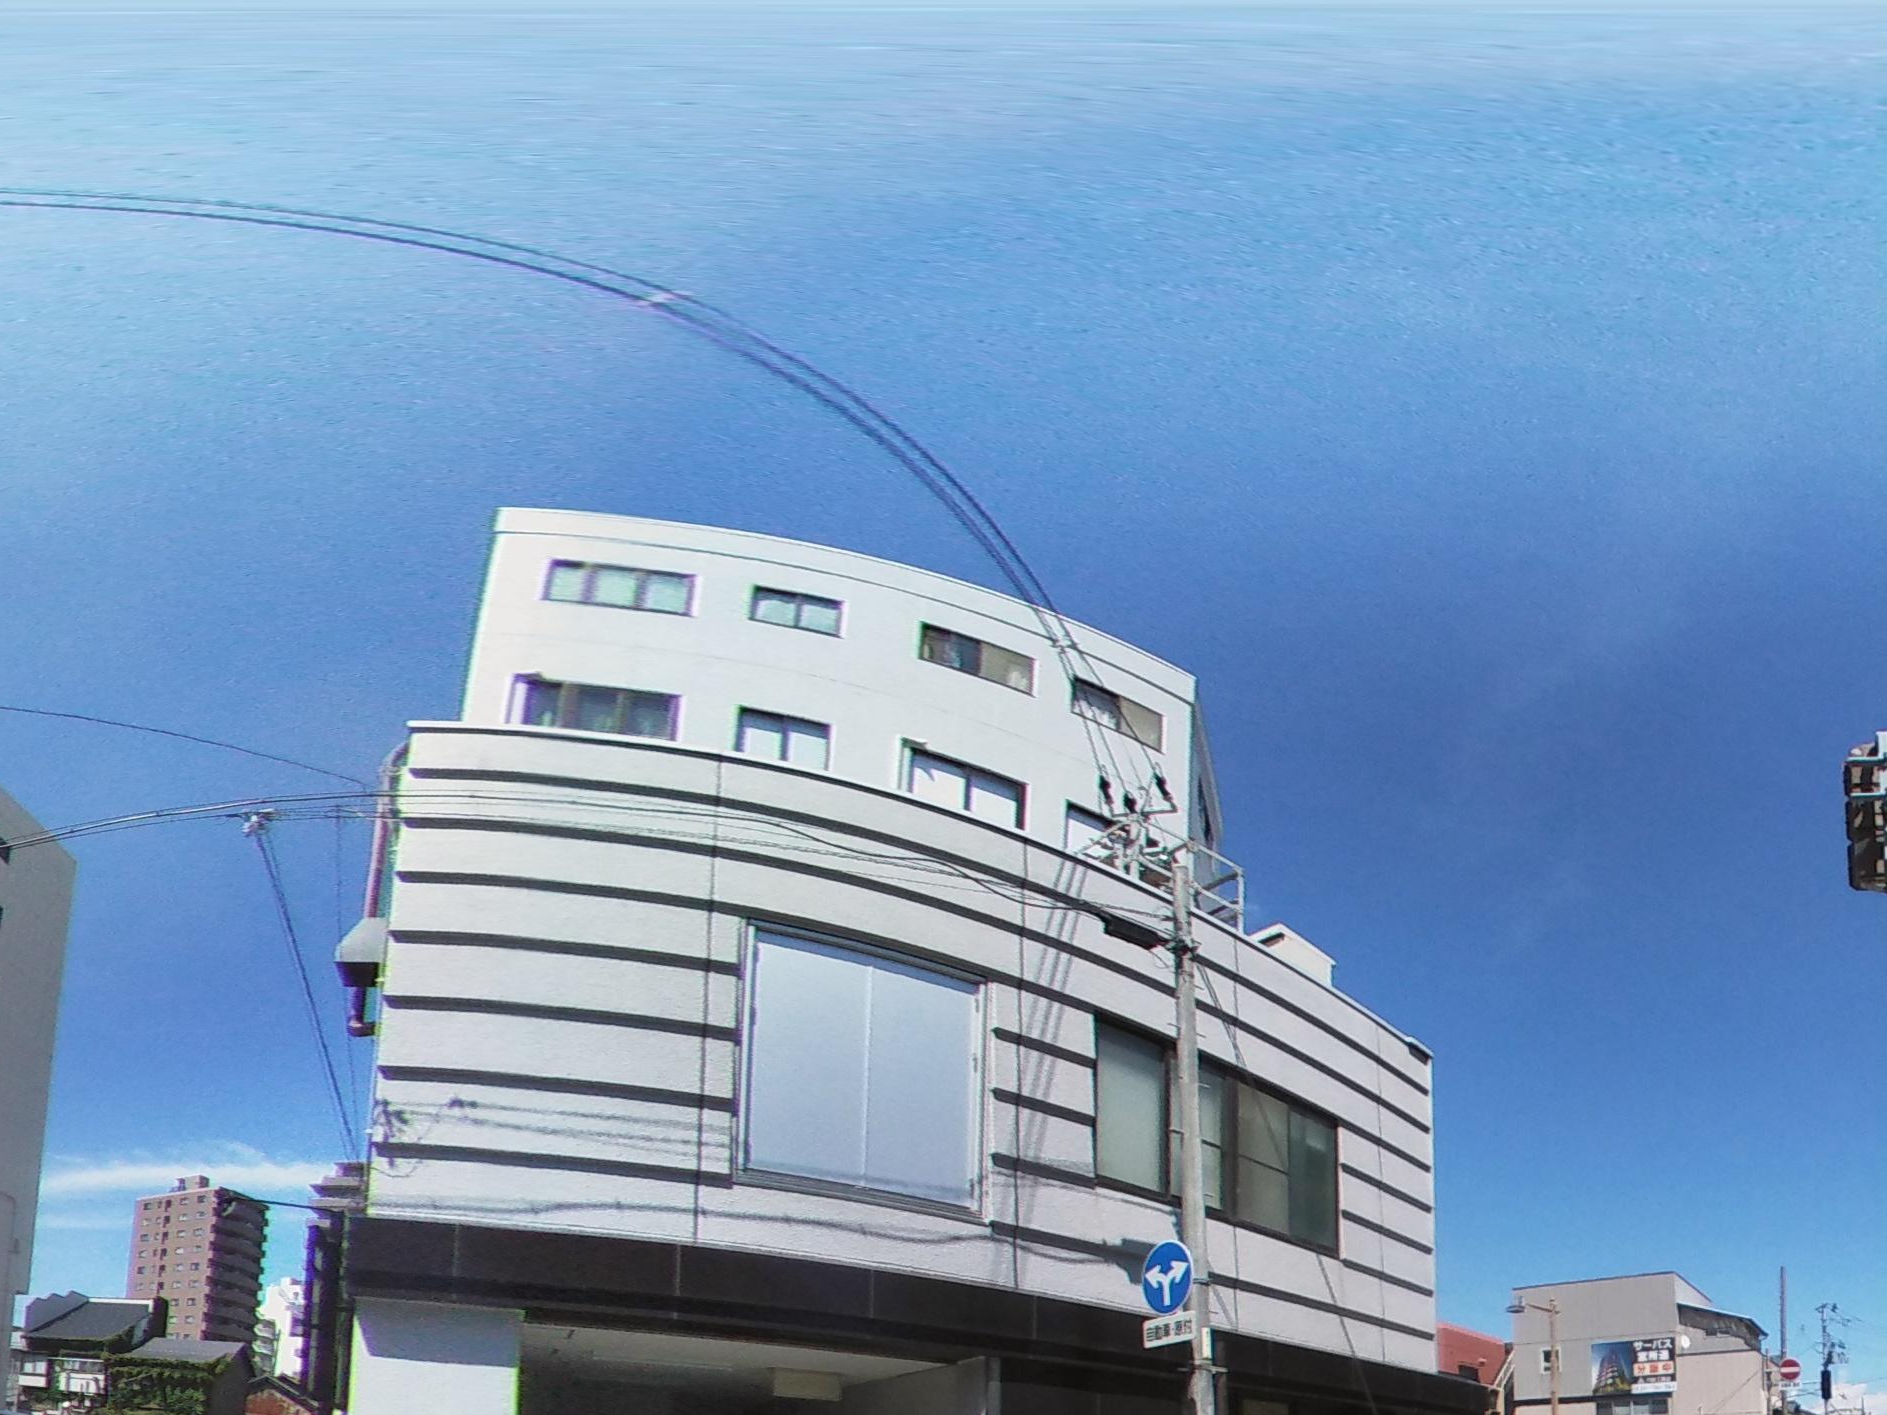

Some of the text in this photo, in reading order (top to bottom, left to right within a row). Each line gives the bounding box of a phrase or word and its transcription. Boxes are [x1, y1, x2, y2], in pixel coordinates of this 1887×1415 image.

[1146, 1317, 1193, 1341] 自動車・原付
